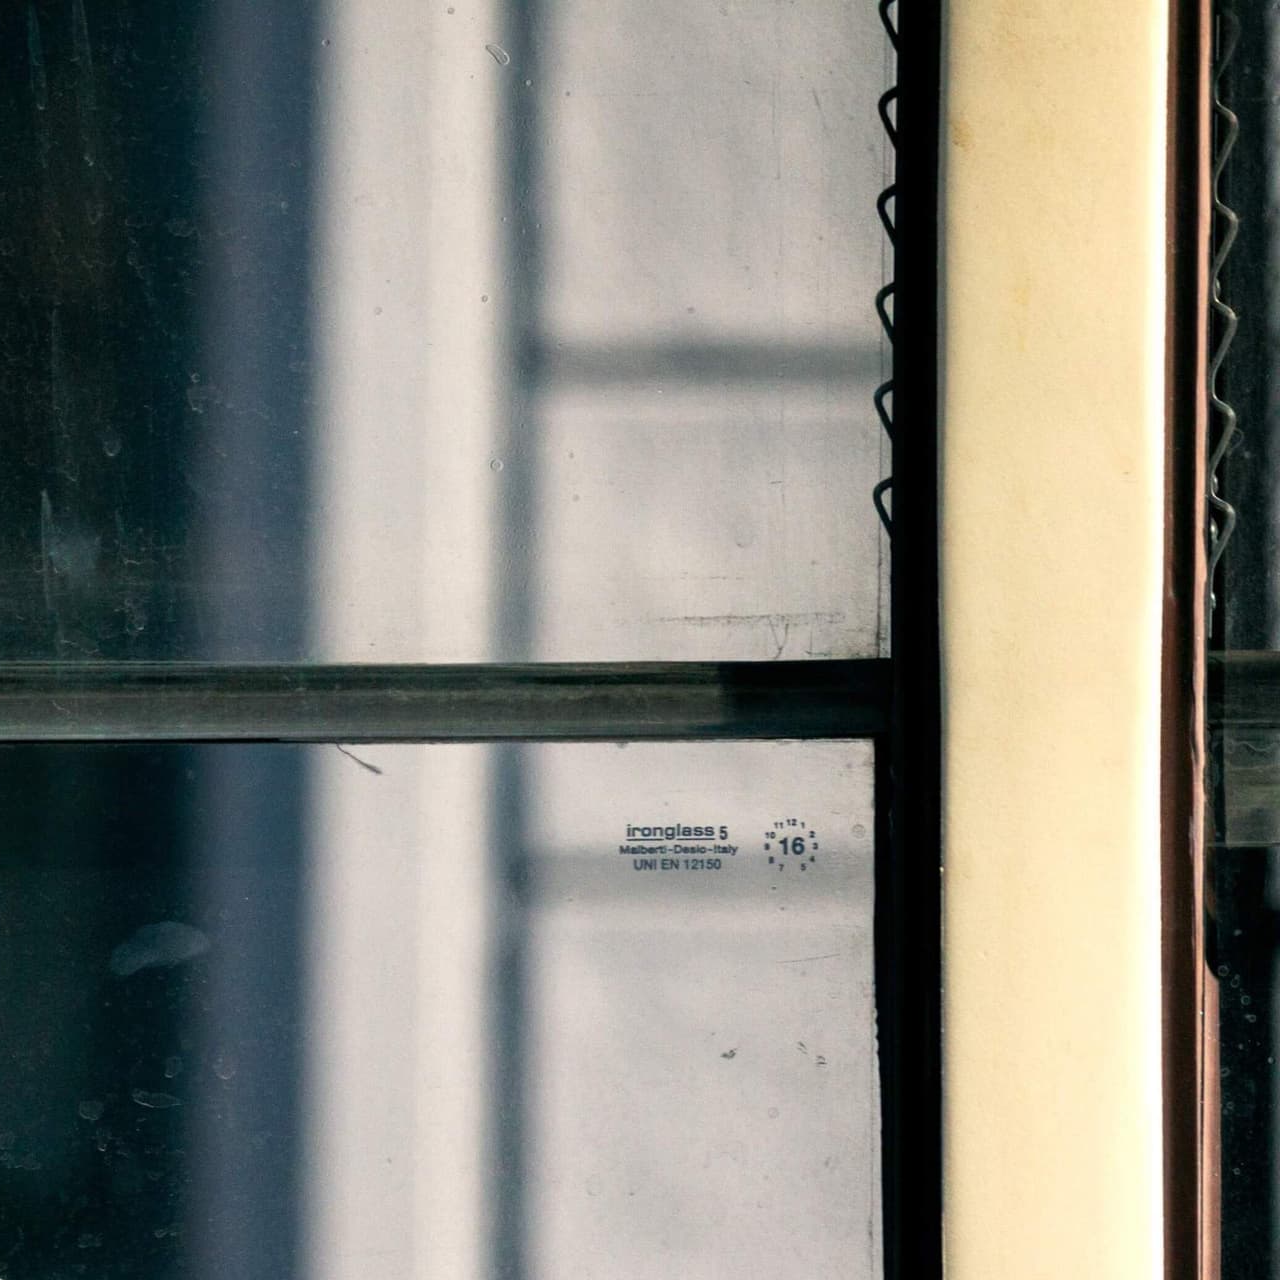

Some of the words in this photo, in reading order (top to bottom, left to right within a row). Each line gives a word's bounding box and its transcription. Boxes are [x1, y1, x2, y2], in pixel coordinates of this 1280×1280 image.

[773, 821, 784, 829] 11
[786, 818, 797, 826] 12
[626, 823, 715, 841] ironglass
[719, 825, 729, 840] 5
[765, 831, 776, 839] 10
[778, 836, 805, 855] 16
[633, 859, 657, 871] UNI
[661, 859, 680, 870] EN
[684, 859, 723, 870] 12150
